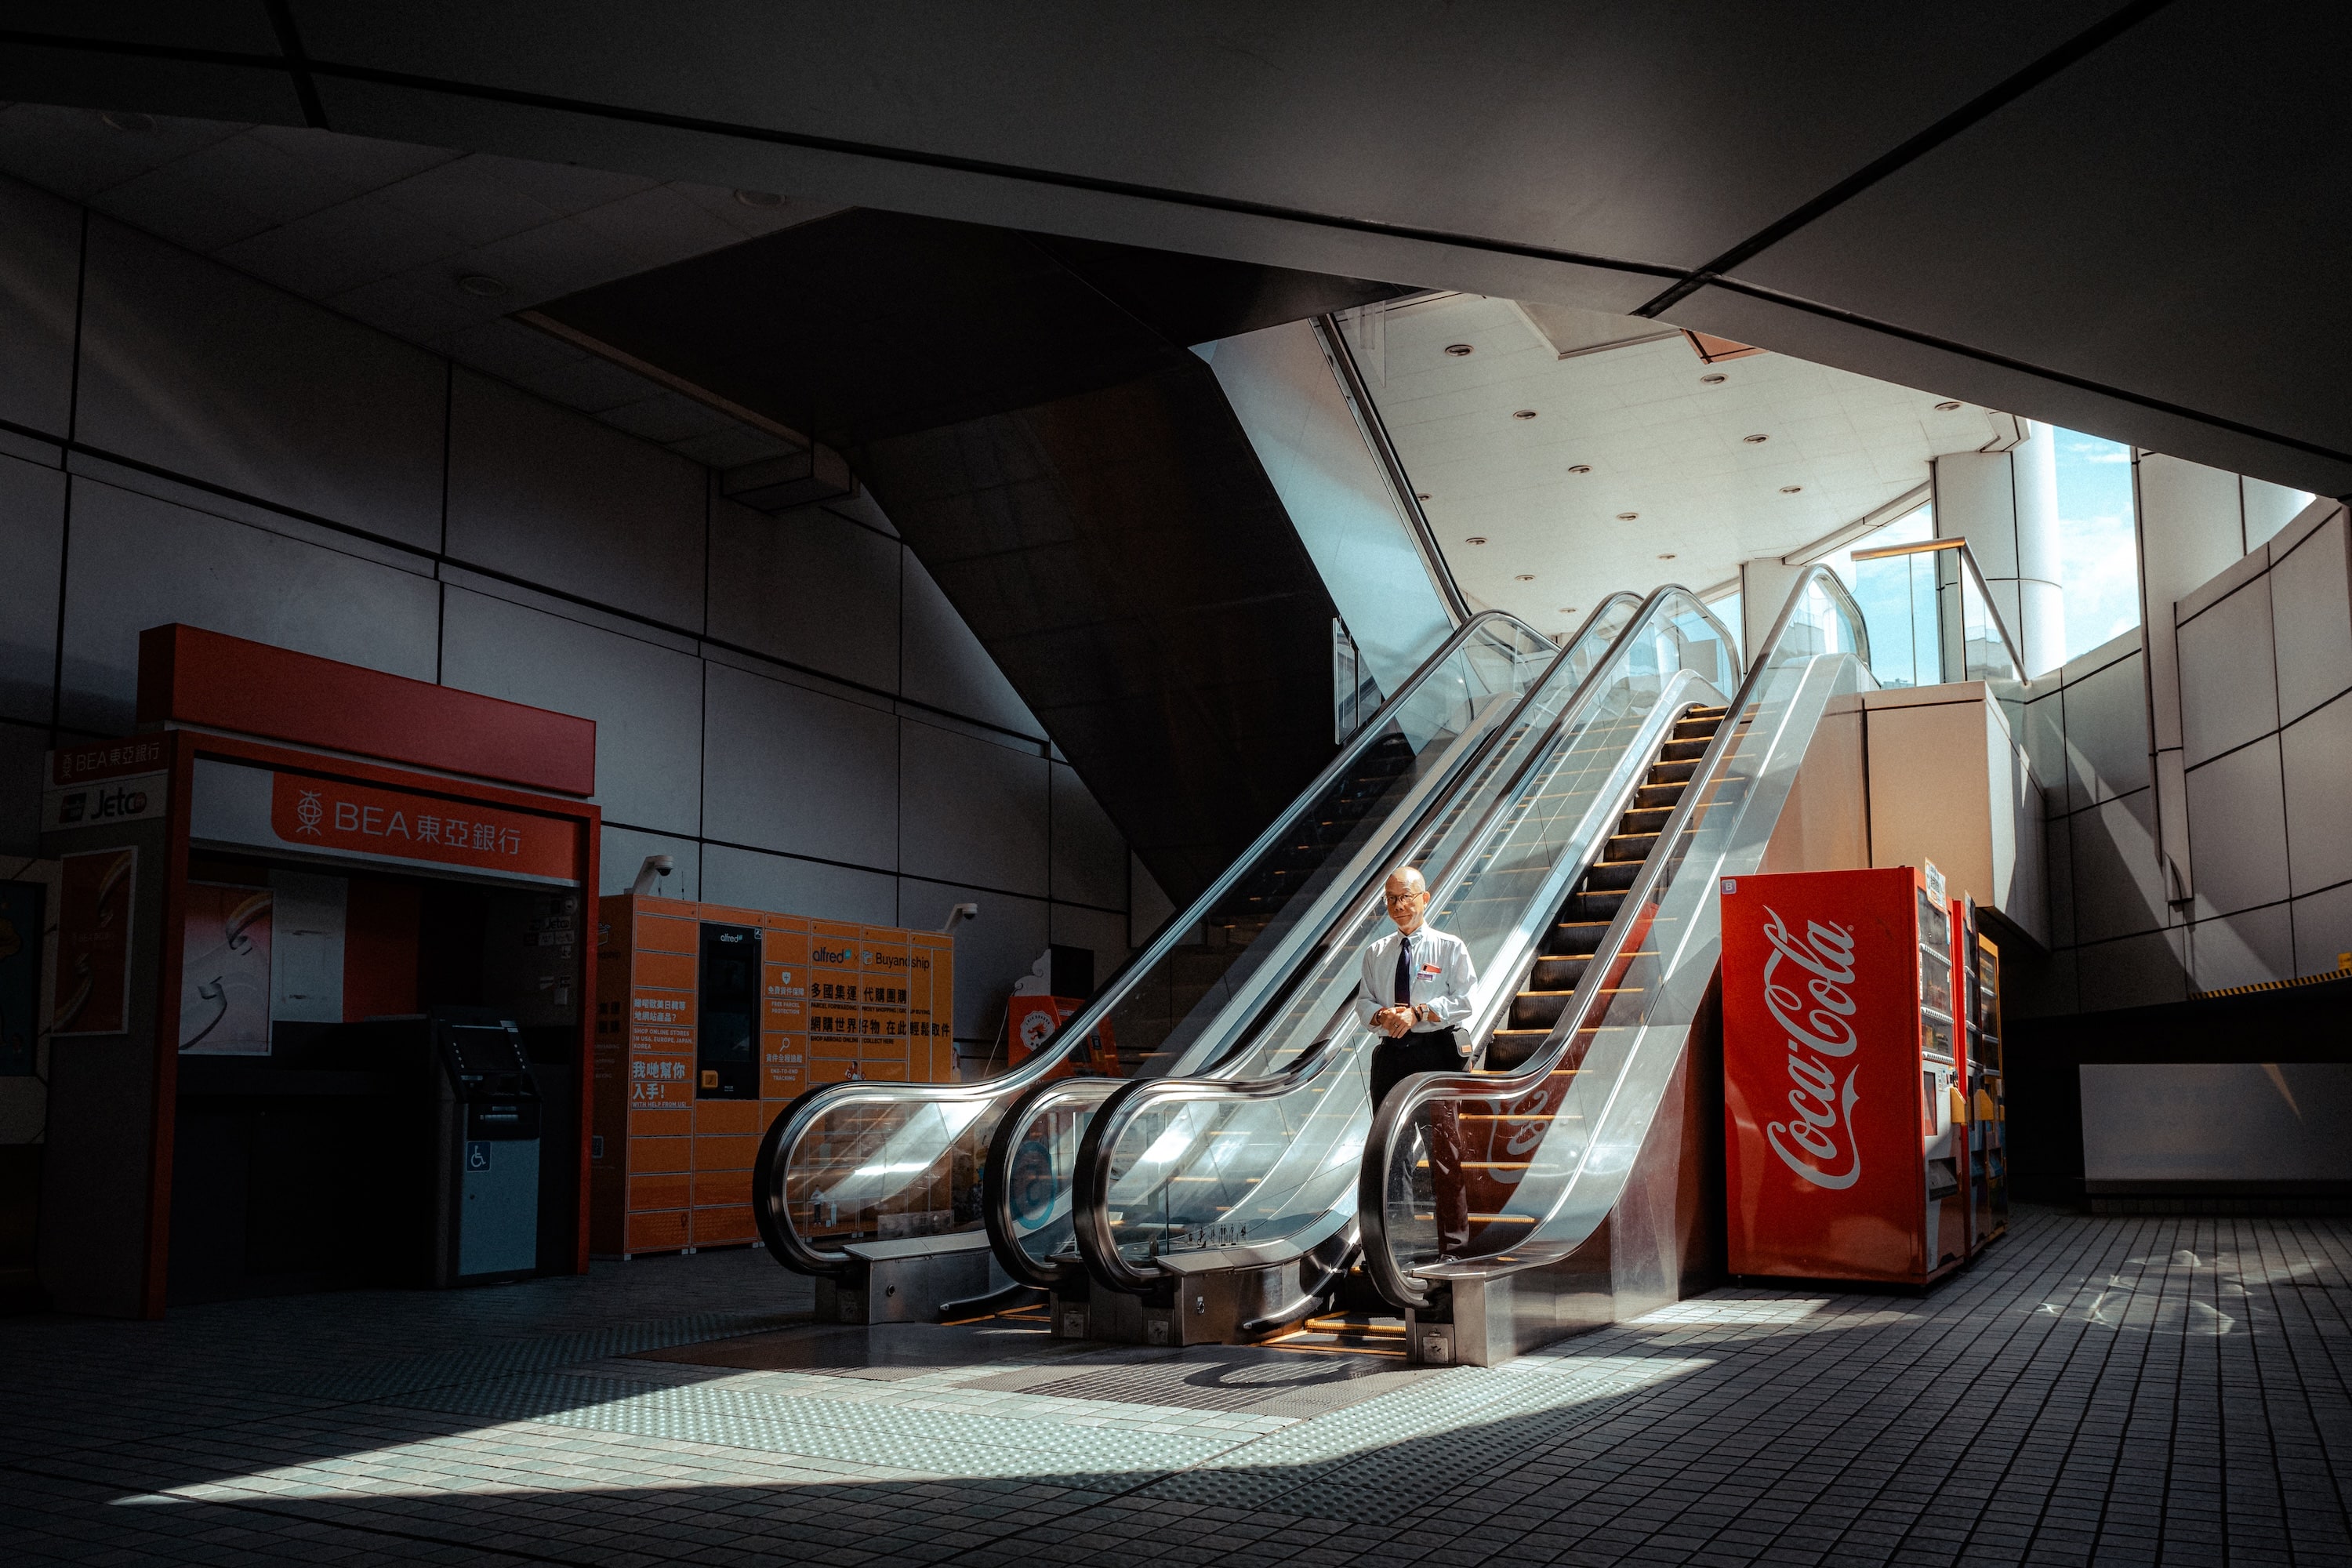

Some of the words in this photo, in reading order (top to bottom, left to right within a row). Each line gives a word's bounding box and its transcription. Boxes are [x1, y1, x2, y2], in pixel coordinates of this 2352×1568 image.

[76, 750, 107, 772] BEA
[109, 742, 161, 766] 東亞銀行
[335, 801, 410, 840] BEA
[416, 815, 521, 855] 東亞銀行
[1726, 882, 1733, 891] B
[720, 933, 739, 943] alfred
[812, 947, 844, 964] alfred
[876, 952, 931, 971] Buyandship
[811, 982, 858, 1001] 多國集運
[863, 986, 907, 1004] 代購團購
[811, 1015, 880, 1035] 網購世界好物
[886, 1020, 949, 1037] 在此輕鬆取件
[1763, 904, 1860, 1190] Coca-Cola
